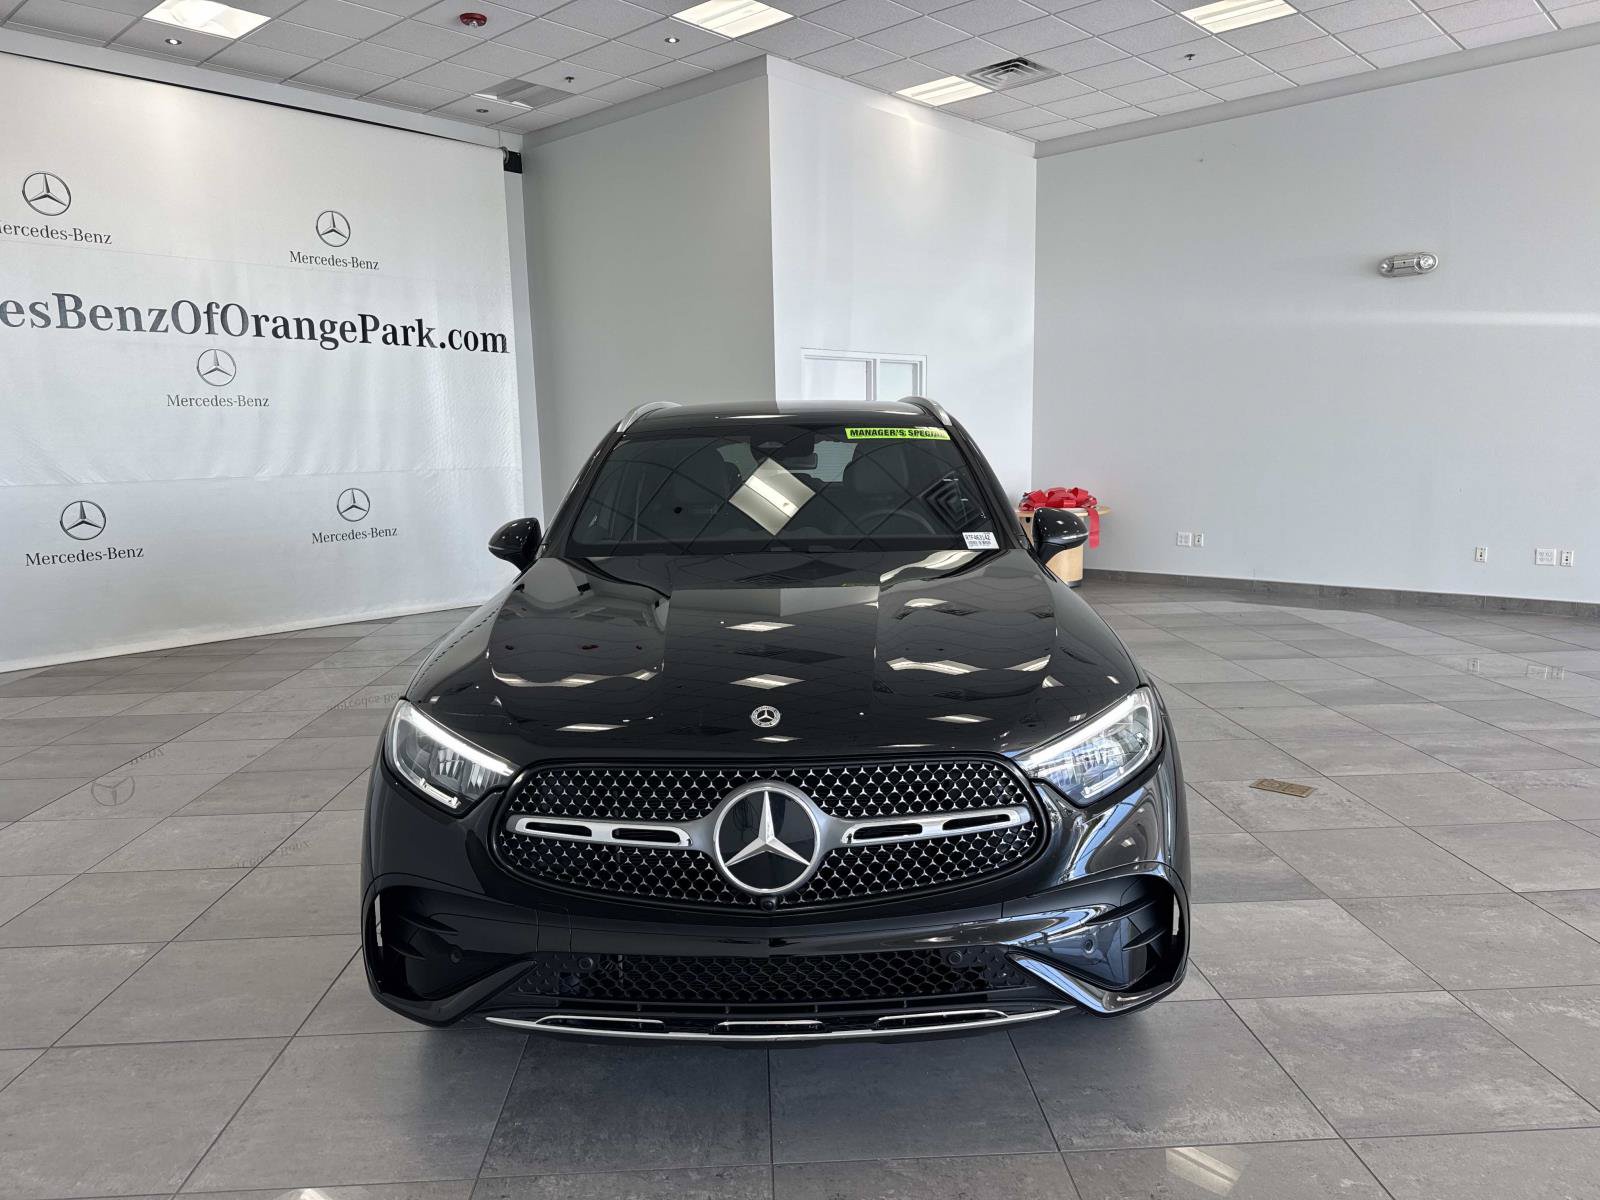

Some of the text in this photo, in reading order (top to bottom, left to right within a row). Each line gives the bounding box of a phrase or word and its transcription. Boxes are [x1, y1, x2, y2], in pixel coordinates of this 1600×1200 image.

[0, 219, 113, 245] ercedes-Benz
[289, 250, 380, 271] Mercedes-Benz
[0, 292, 510, 354] esBenzOfOrangePark.com
[166, 394, 270, 408] Mercedes-Benz
[312, 527, 398, 545] Mercedes-Benz
[25, 546, 144, 567] Mercedes-Benz
